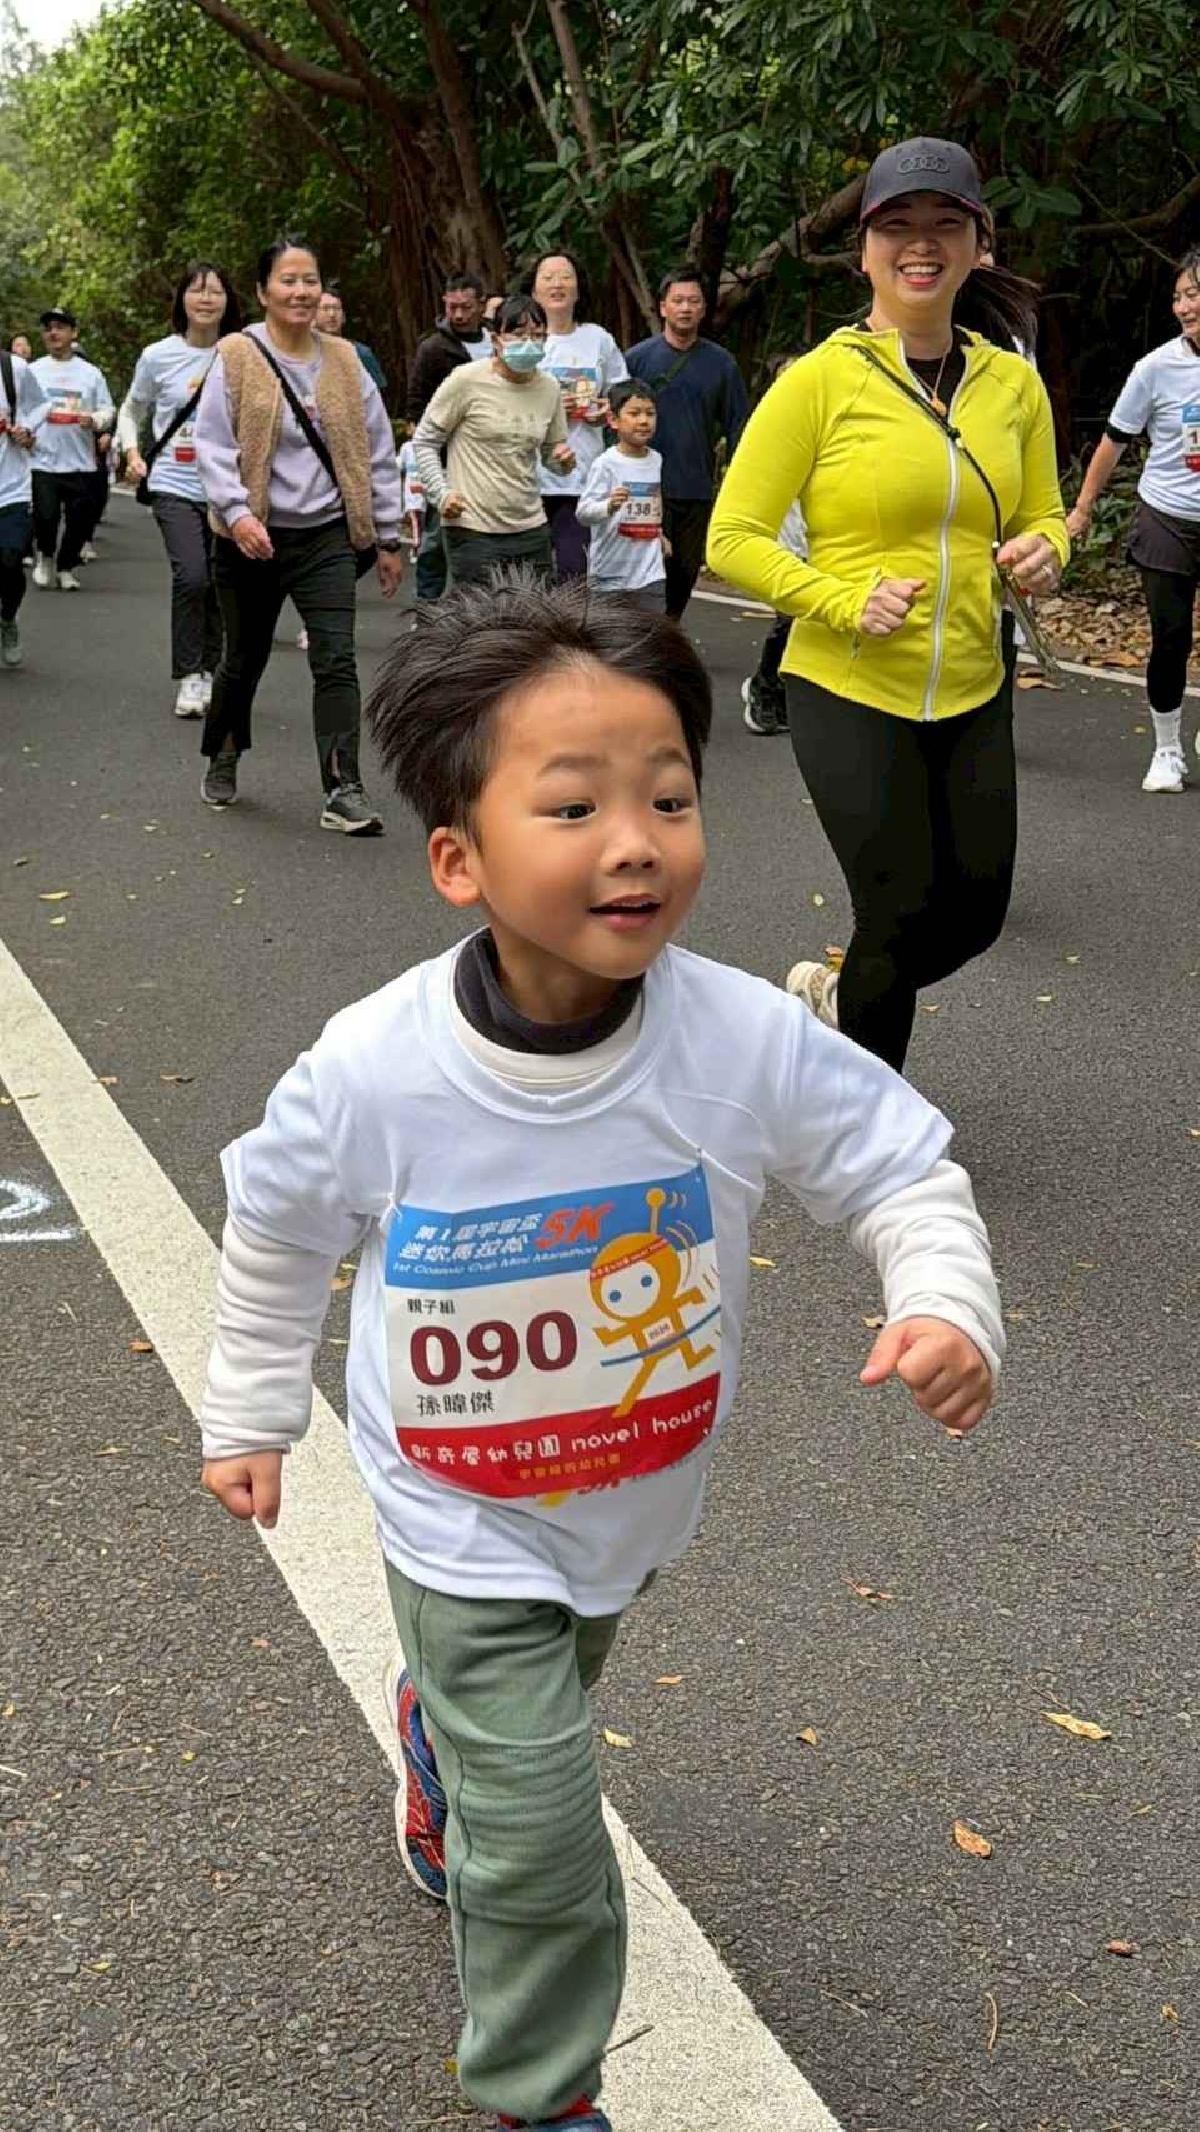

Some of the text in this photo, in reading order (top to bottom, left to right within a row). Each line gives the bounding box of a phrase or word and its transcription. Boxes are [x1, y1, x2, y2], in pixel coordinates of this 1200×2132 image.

[534, 1202, 617, 1249] 5K
[407, 1298, 455, 1315] 親子組
[410, 1310, 578, 1386] 090
[571, 1421, 639, 1452] novel
[652, 1399, 713, 1435] house
